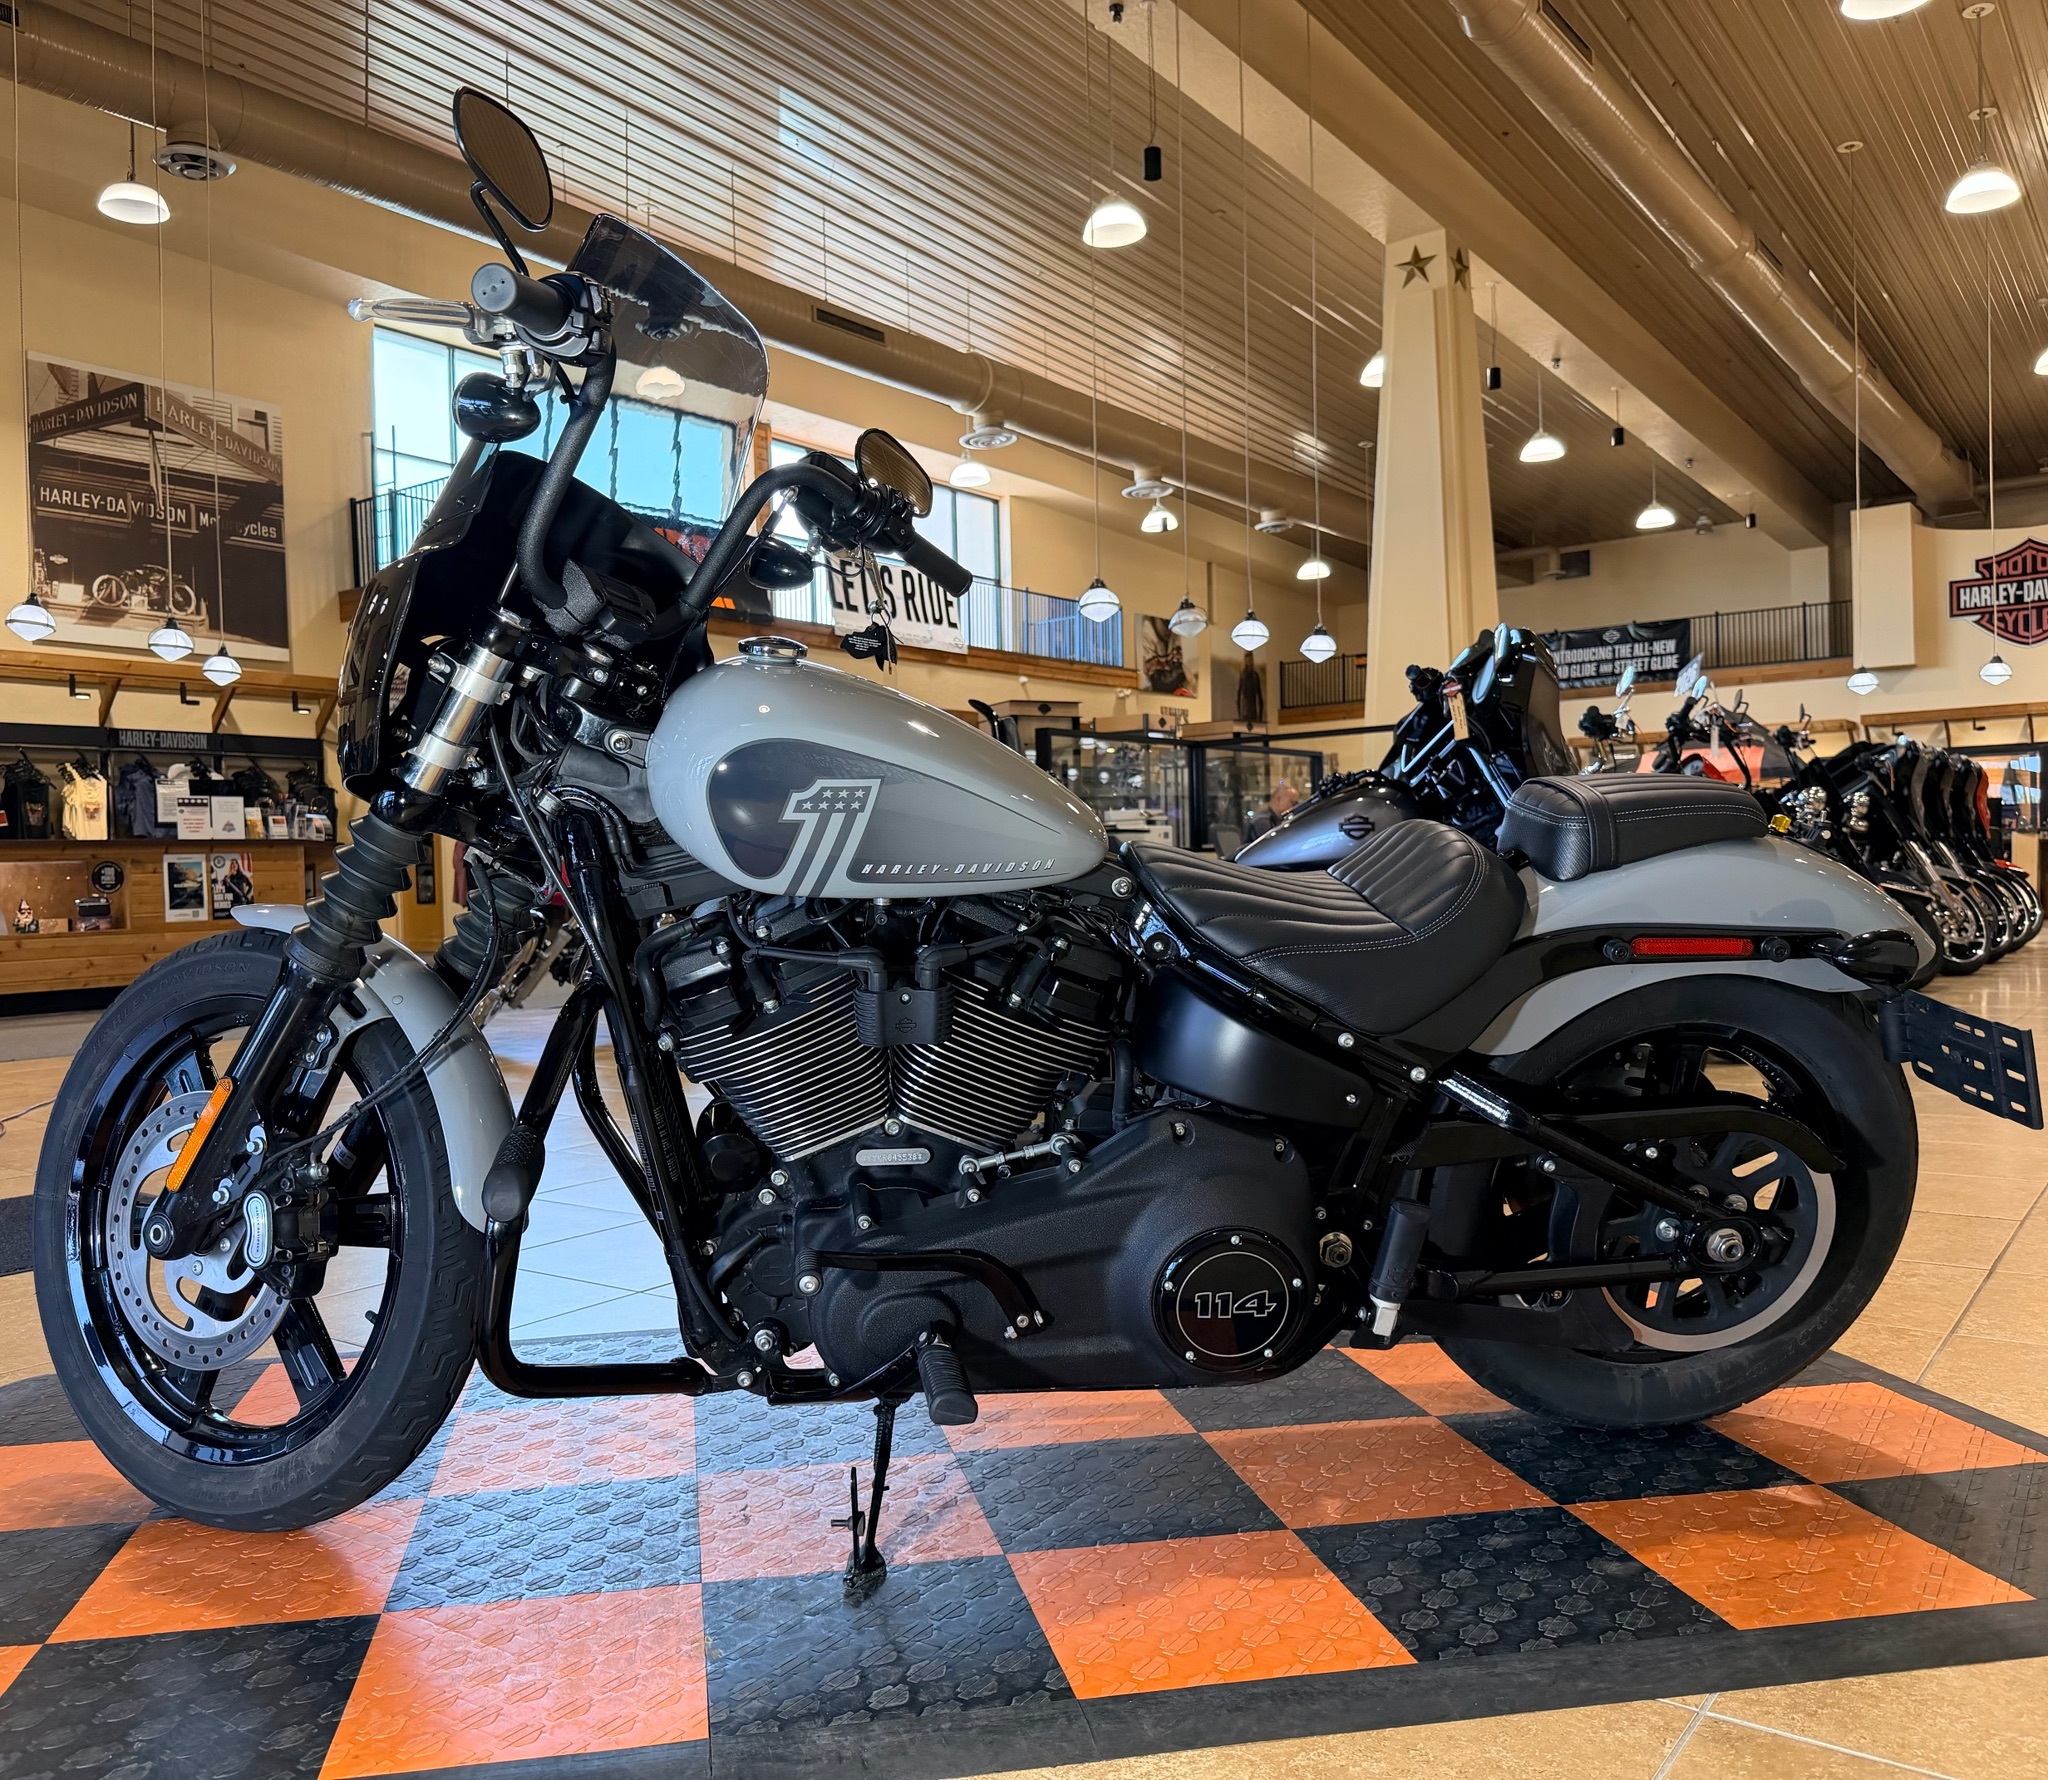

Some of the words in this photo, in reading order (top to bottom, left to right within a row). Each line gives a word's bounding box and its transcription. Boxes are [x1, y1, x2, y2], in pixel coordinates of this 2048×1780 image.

[31, 392, 138, 435] HARLEY-DAVIDSON
[156, 395, 282, 475] HARLEY-DAVIDSON
[39, 486, 187, 524] HARLEY-DAVIDSON
[901, 569, 959, 630] RIDE
[1552, 645, 1613, 665] NTRODUCING
[1613, 643, 1633, 659] THE
[1633, 638, 1676, 657] ALL-NEW
[1570, 662, 1598, 679] GLIDE
[1650, 653, 1680, 671] GLIDE
[118, 730, 208, 750] HARLEY-DAVIDSON
[860, 857, 1056, 877] HARLEY-DAVIDSON
[1194, 1290, 1277, 1319] 114
